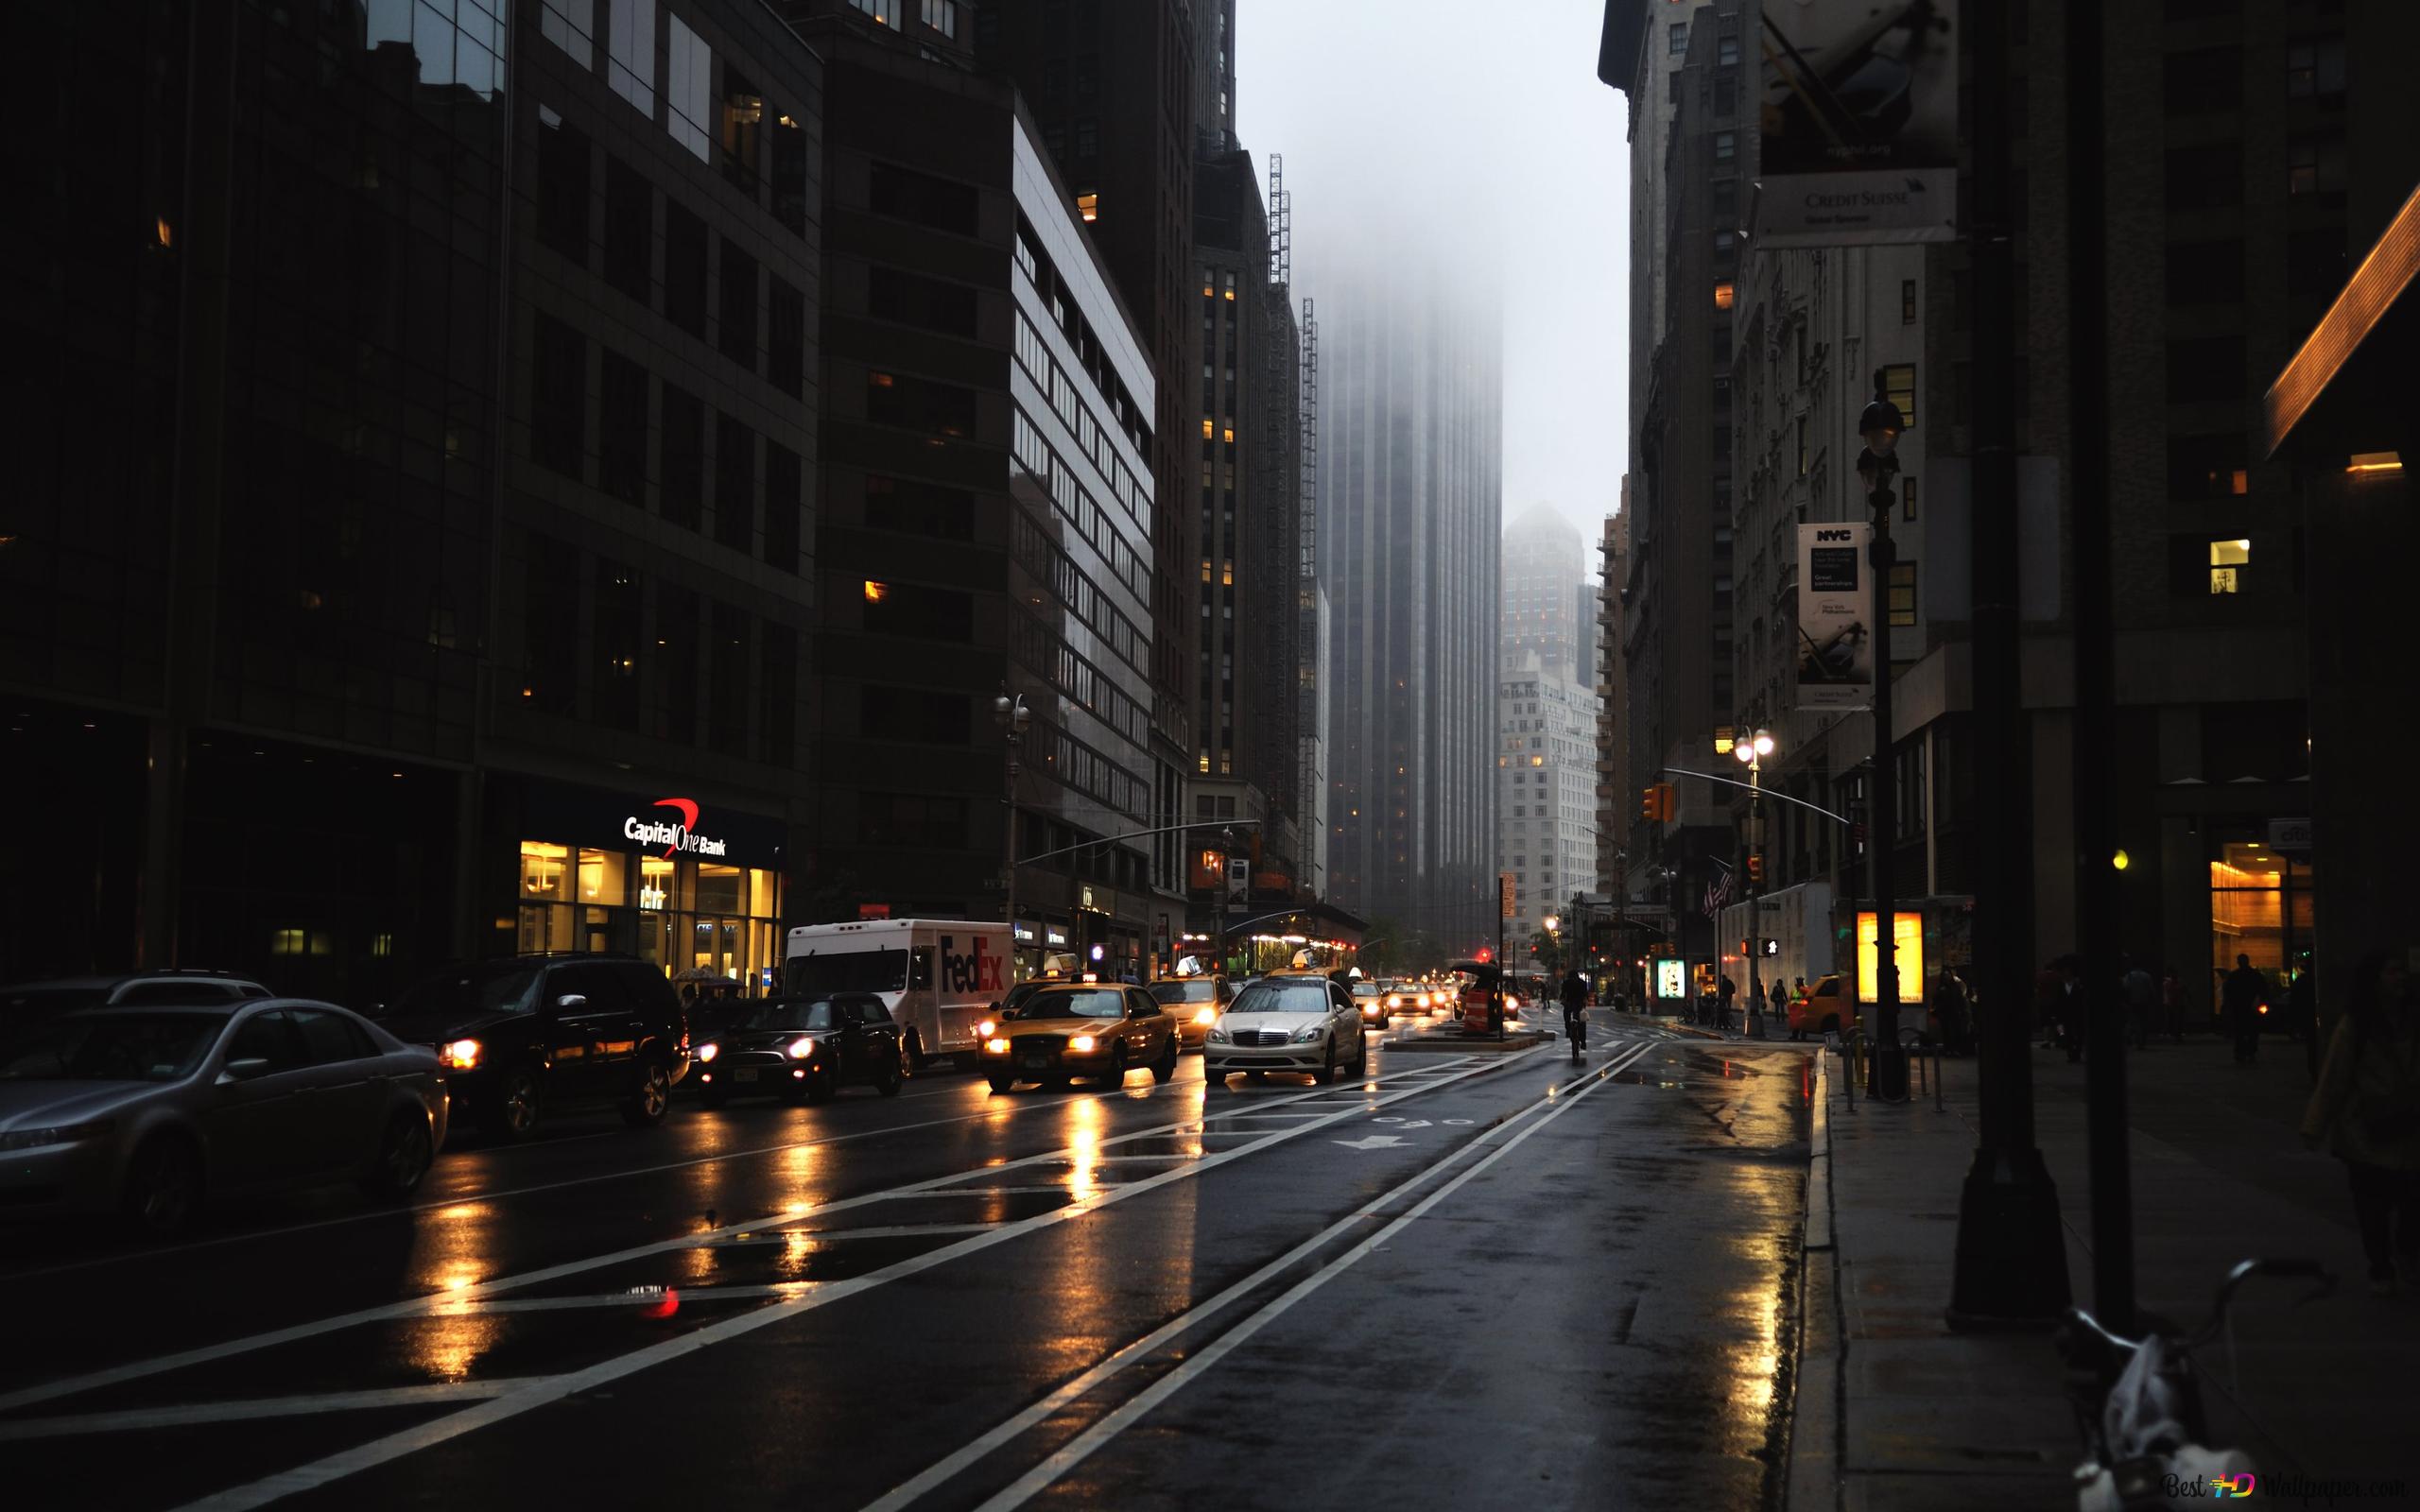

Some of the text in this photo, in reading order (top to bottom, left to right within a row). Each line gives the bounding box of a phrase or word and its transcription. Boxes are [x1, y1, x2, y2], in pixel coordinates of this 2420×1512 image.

[1826, 144, 1891, 158] nyphil.org
[1805, 191, 1908, 208] CREDIT SUISSE
[1817, 530, 1851, 541] NYC
[700, 836, 726, 856] Bank
[941, 936, 1004, 994] FedEx
